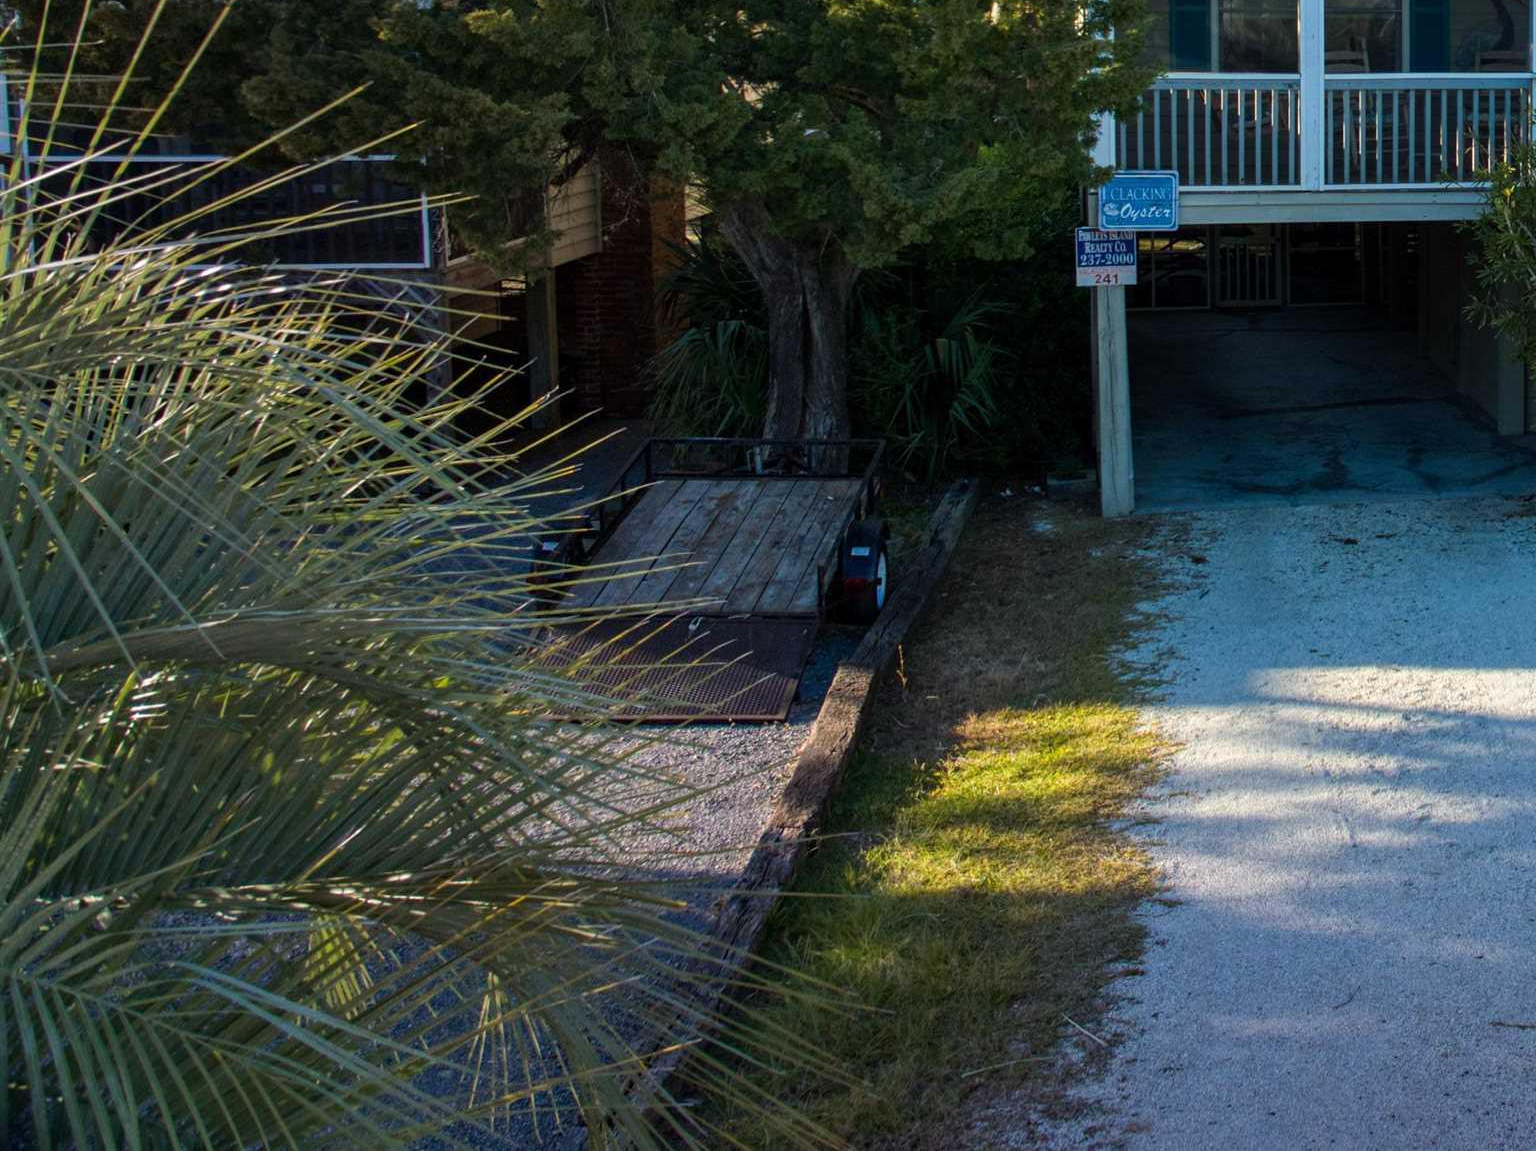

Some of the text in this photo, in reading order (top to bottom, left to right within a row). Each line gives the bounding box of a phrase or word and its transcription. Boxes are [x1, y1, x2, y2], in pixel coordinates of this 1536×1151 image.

[1110, 187, 1171, 201] CLACKING
[1120, 203, 1171, 221] Oyster
[1080, 254, 1133, 266] 237-2000
[1095, 274, 1119, 284] 241
